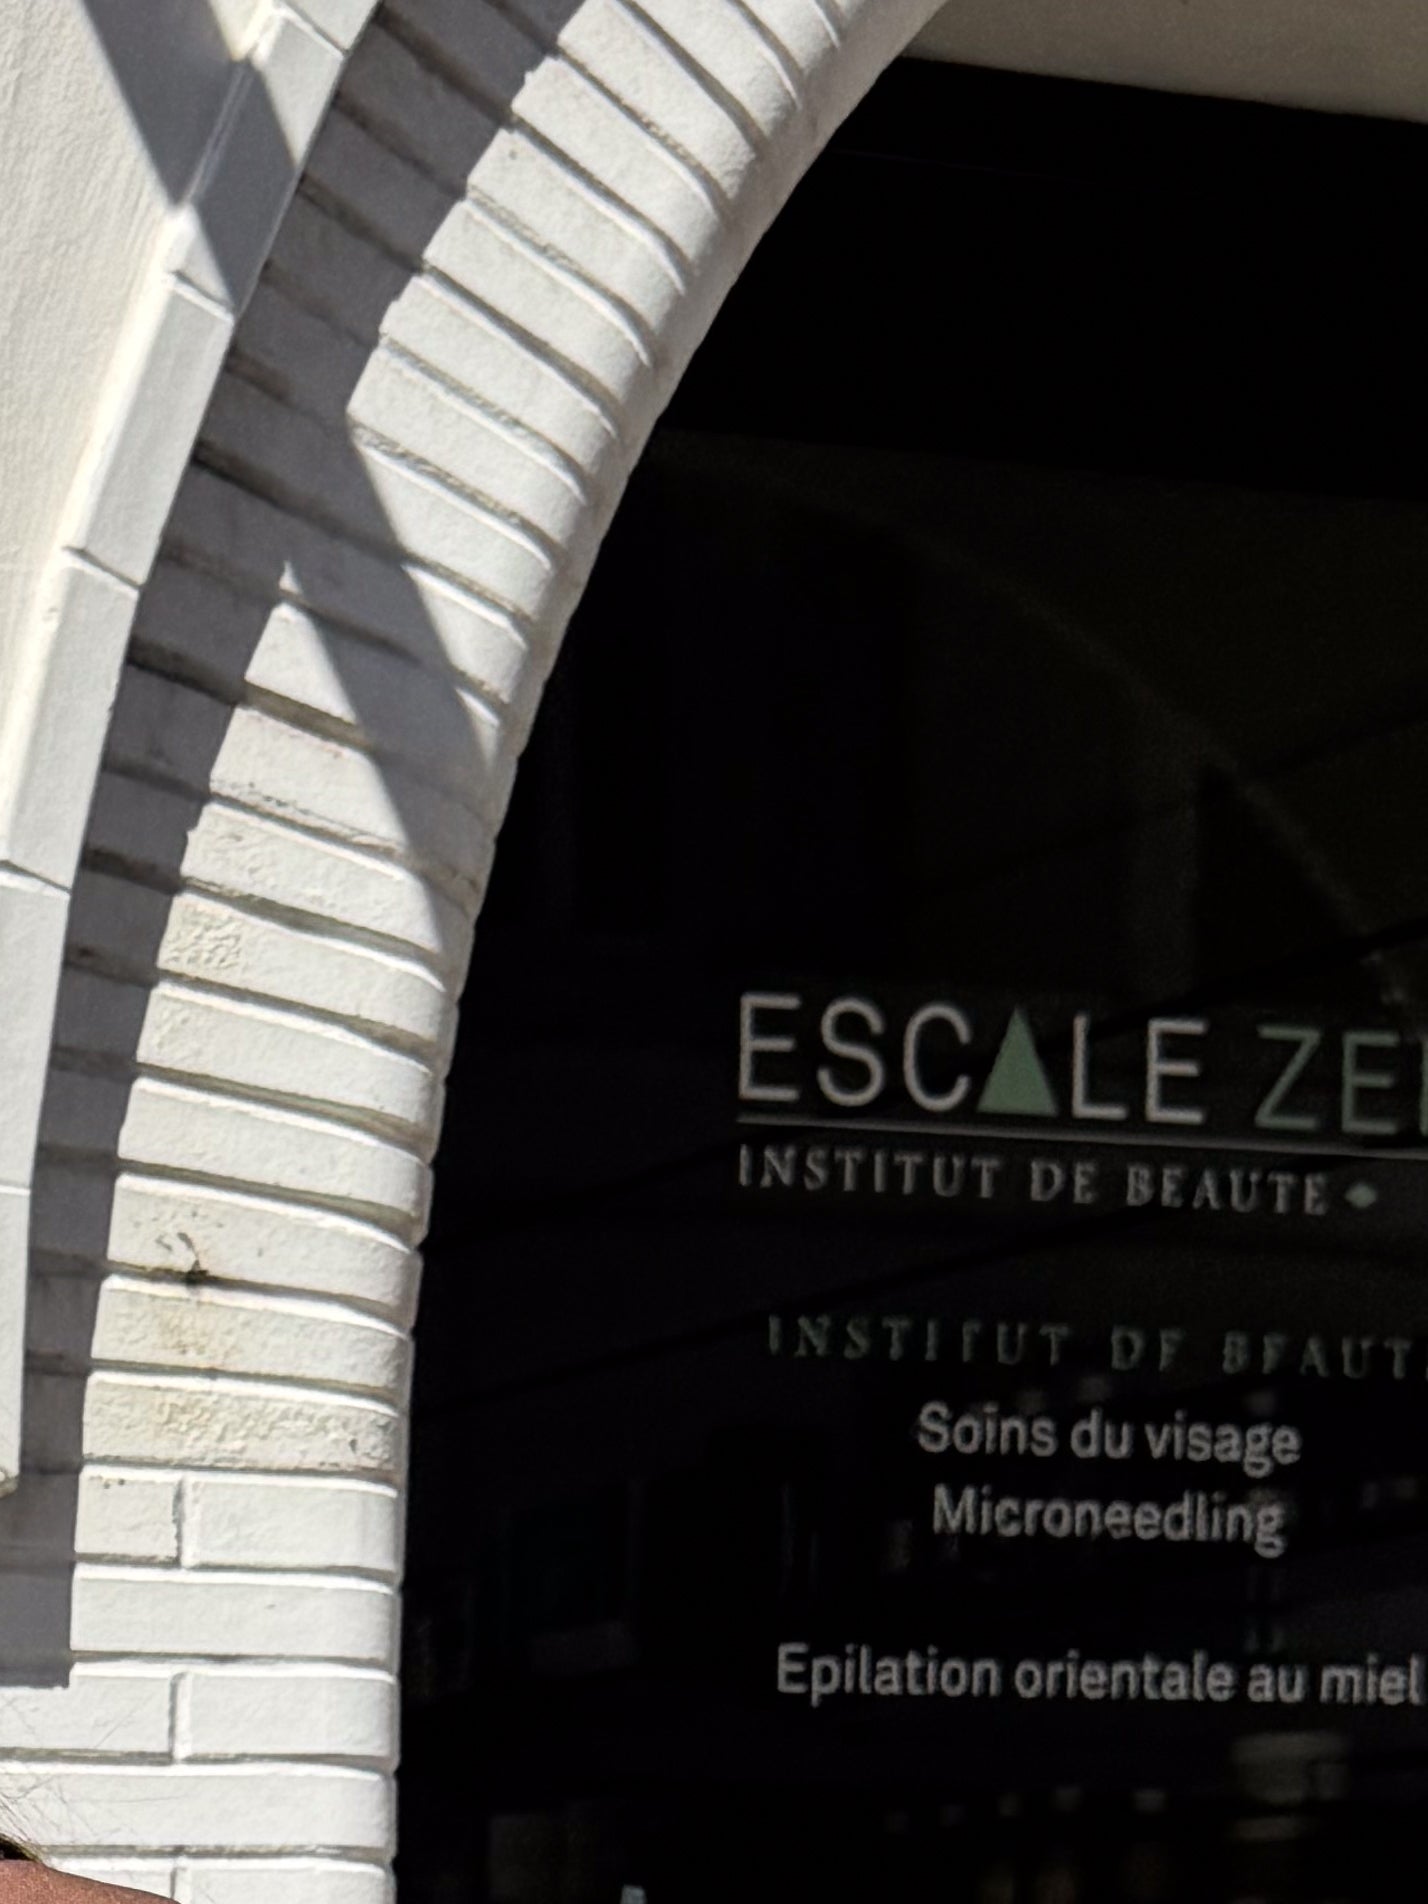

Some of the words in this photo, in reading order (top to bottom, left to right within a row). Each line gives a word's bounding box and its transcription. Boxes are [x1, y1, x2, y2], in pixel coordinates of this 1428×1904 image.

[1254, 1025, 1428, 1136] ZE
[738, 1144, 1001, 1199] INSTITUT
[1030, 1160, 1095, 1204] DE
[1126, 1165, 1325, 1215] BEAUTE
[1222, 1331, 1428, 1380] BEAUT
[918, 1402, 1056, 1457] Soins
[1070, 1409, 1130, 1459] du
[1145, 1411, 1300, 1479] visage
[933, 1483, 1287, 1560] Microneedling
[777, 1642, 1001, 1707] Epilation
[1014, 1650, 1234, 1701] orientale
[1248, 1665, 1304, 1702] au
[1320, 1657, 1420, 1705] miel
